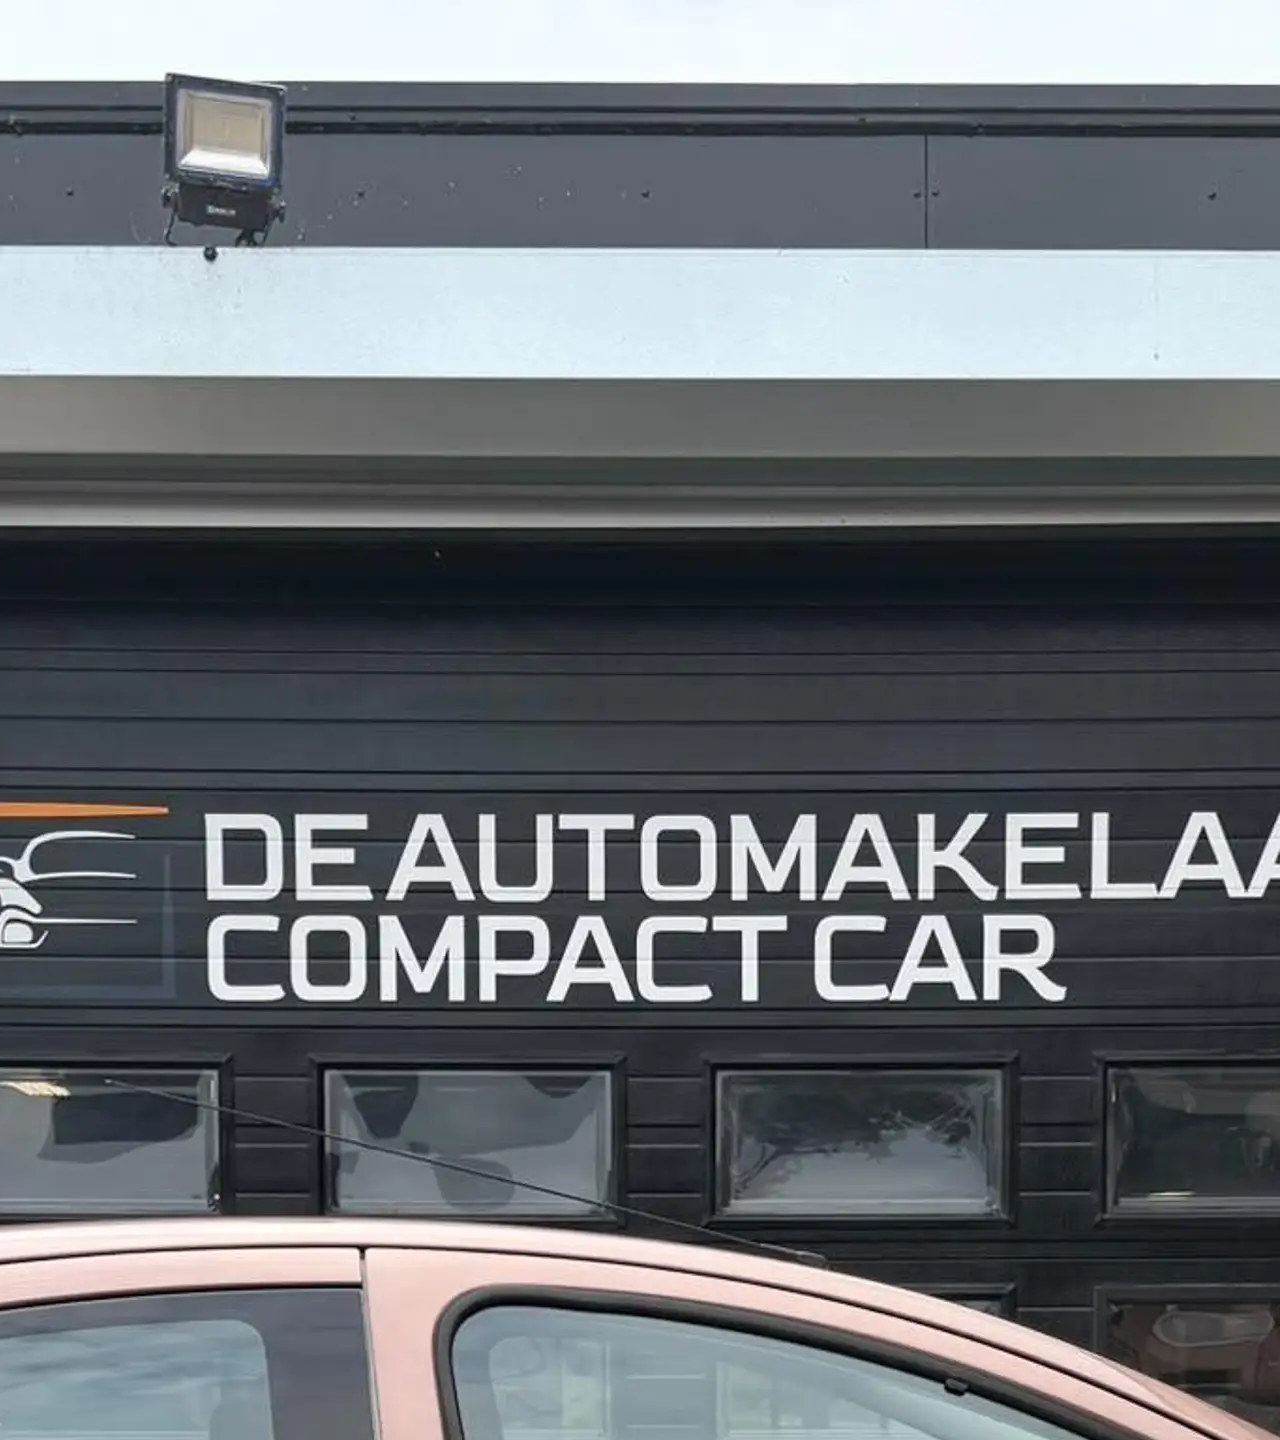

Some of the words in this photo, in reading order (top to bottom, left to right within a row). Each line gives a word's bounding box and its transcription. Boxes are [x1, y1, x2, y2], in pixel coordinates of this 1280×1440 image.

[204, 812, 374, 902] DE
[206, 914, 788, 1002] COMPACT
[814, 914, 1067, 1002] CAR
